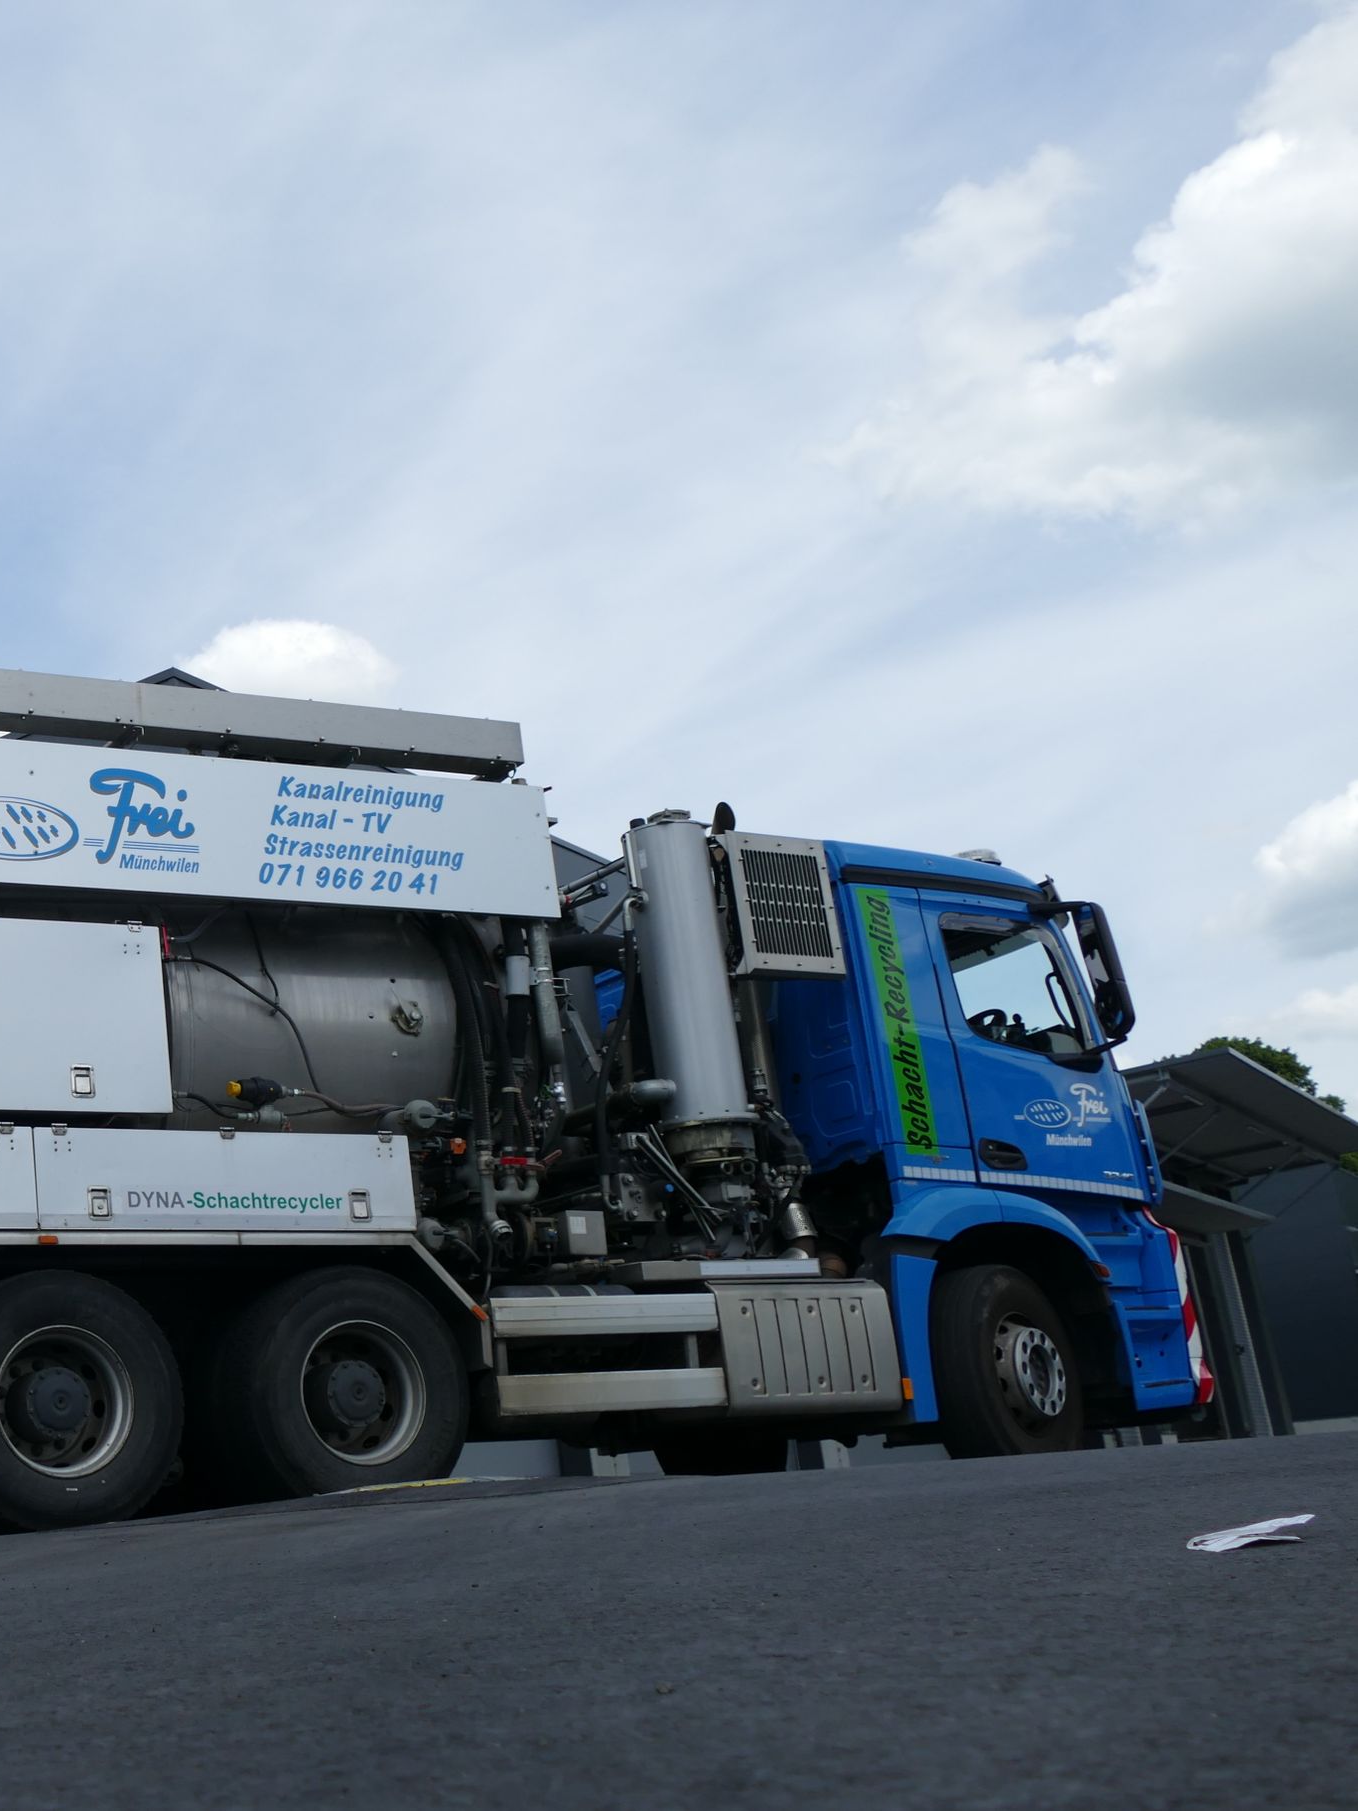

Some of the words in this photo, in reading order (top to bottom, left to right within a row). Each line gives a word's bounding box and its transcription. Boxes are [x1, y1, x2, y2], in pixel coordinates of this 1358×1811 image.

[277, 776, 444, 812] Kanalreinigung
[89, 768, 196, 864] Frei
[270, 805, 335, 830] Kanal
[362, 812, 393, 834] TV
[118, 853, 200, 874] Münchwilen
[264, 833, 464, 871] Strassenreinigung
[258, 862, 305, 887] 071
[315, 866, 363, 890] 966
[370, 870, 403, 894] 20
[408, 872, 439, 896] 41
[866, 895, 933, 1150] Schacht-Recycling
[1070, 1083, 1108, 1127] Frei
[1046, 1133, 1092, 1146] Münchwilen
[127, 1191, 342, 1214] DYNA-Schachtrecycler
